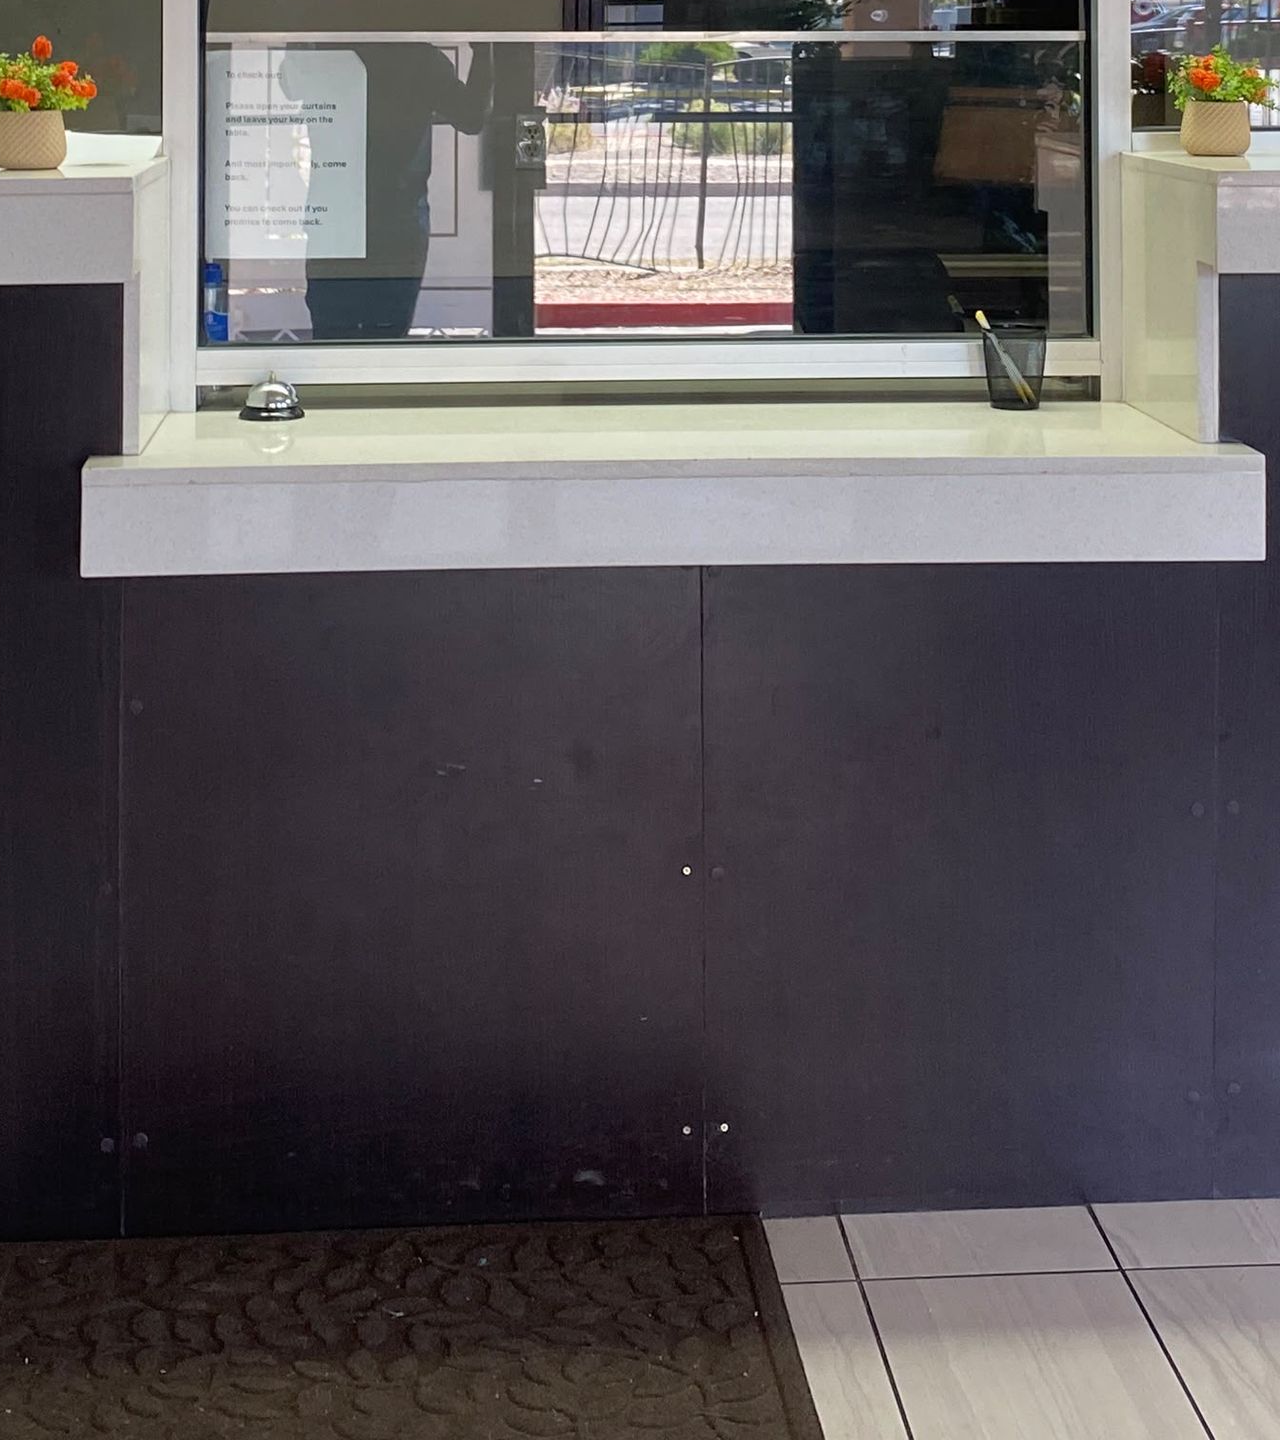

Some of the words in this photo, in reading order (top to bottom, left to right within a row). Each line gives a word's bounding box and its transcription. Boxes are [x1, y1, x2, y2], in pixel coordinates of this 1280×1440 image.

[225, 70, 236, 79] To
[225, 102, 254, 110] Please
[301, 102, 336, 110] curtains
[225, 115, 242, 124] and
[243, 115, 267, 124] leave
[268, 116, 288, 125] your
[289, 115, 305, 125] key
[224, 204, 240, 212] You
[312, 206, 328, 214] you
